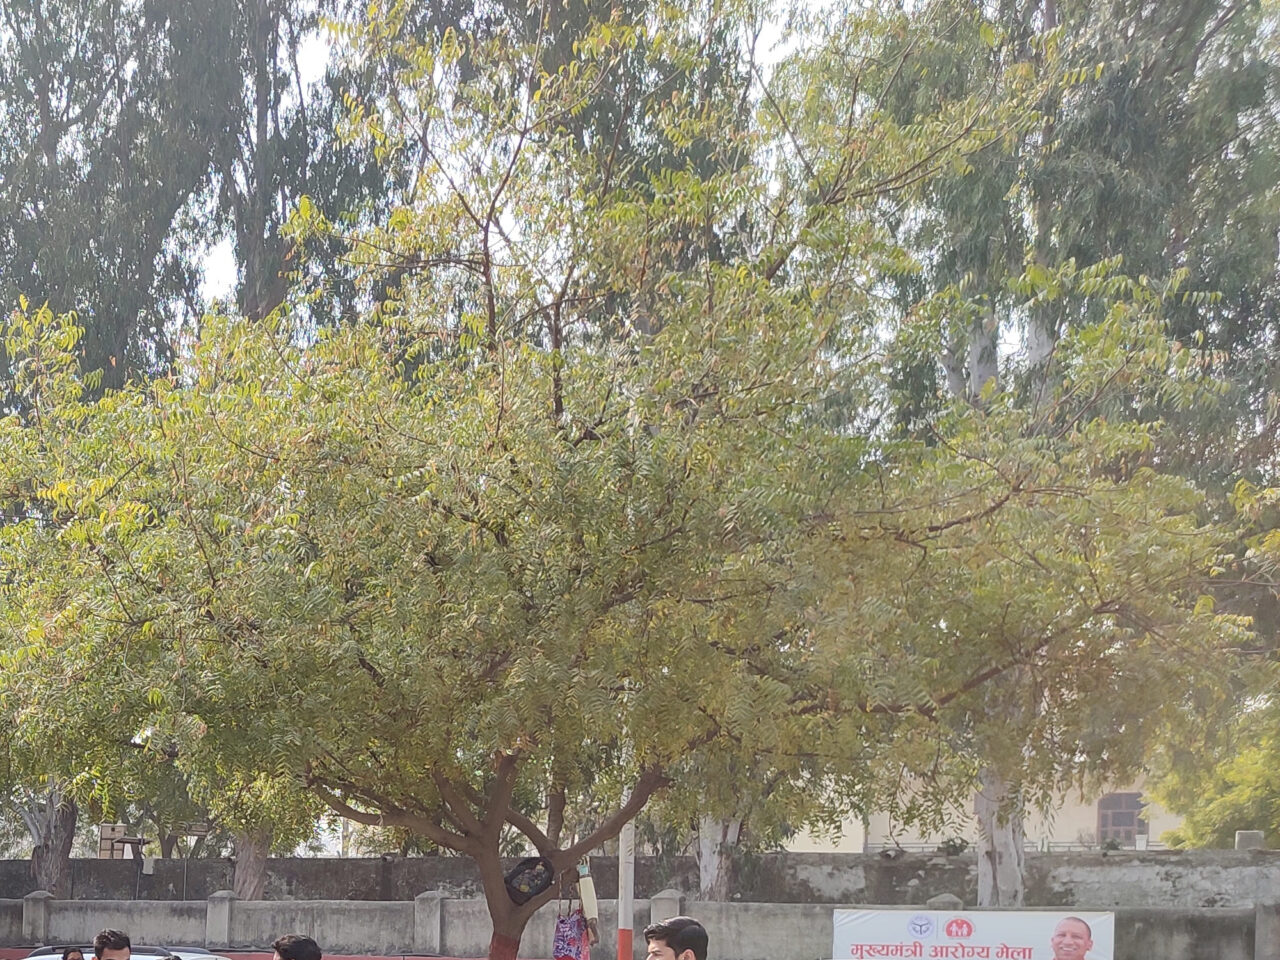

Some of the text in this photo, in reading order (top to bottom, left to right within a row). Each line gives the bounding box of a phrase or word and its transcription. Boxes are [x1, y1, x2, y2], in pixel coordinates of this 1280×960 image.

[850, 940, 1034, 960] मुख्यमंत्री आरोग्य मेला
